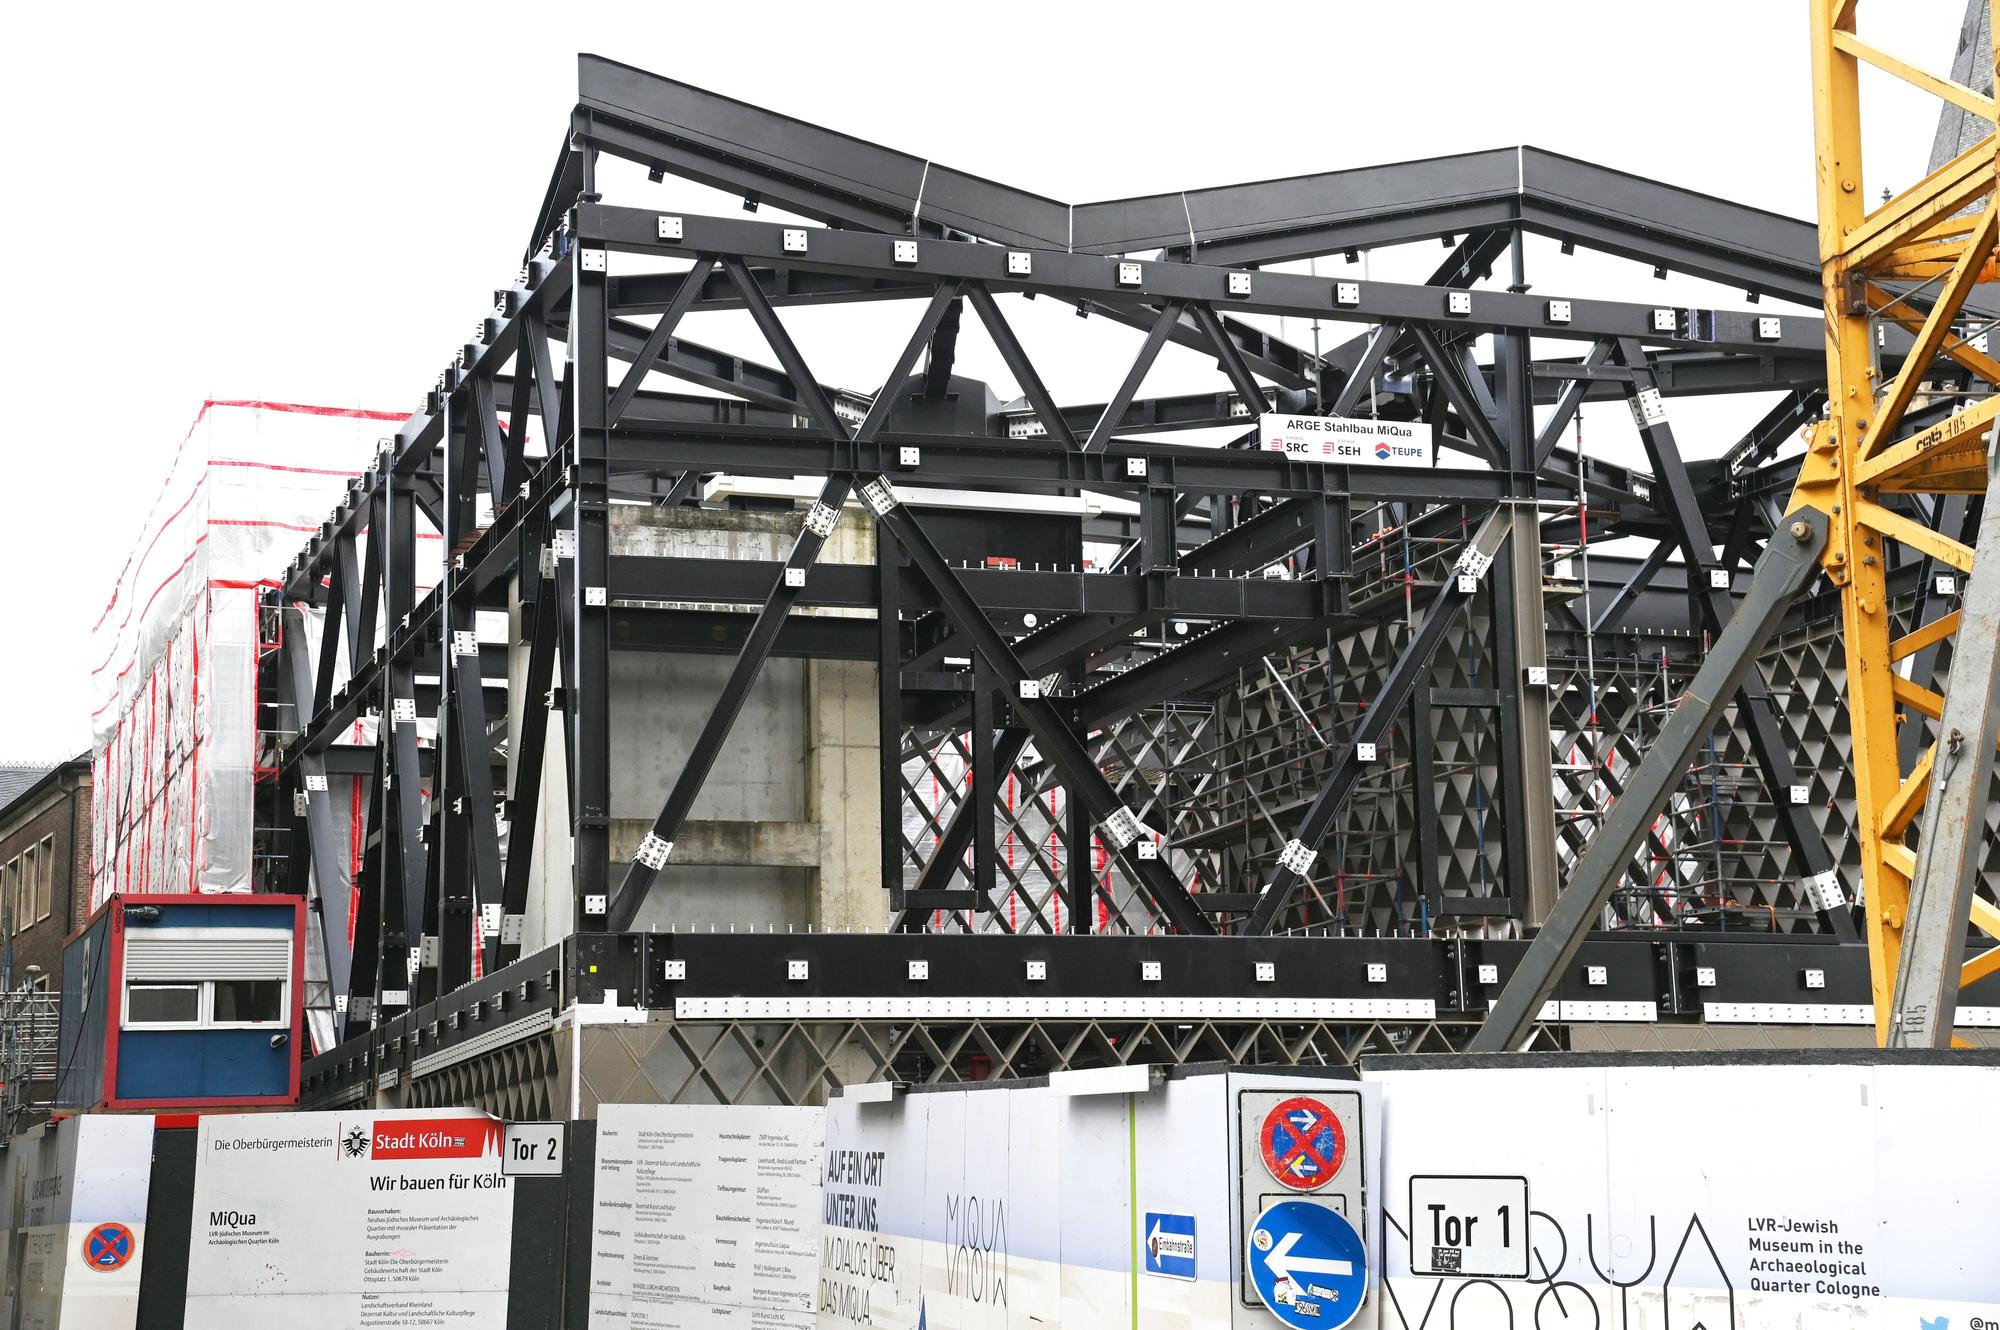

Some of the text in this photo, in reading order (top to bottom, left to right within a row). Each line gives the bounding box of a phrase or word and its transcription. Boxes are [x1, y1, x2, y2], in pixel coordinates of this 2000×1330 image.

[1286, 419, 1412, 437] ARGE Stahlbau MiQua
[1286, 442, 1308, 453] SRC
[1338, 446, 1360, 456] SEH
[1392, 446, 1422, 457] TEUPE
[214, 1138, 333, 1152] Die Oberbürgermeisterin
[376, 1132, 416, 1150] Stadt
[419, 1132, 452, 1148] Köln
[512, 1138, 557, 1161] Tor 2
[828, 1150, 885, 1187] AUF EIN ORT
[370, 1173, 506, 1190] Wir bauen für Köln
[210, 1211, 256, 1228] MiQua
[826, 1192, 878, 1232] UNTER UNS.
[1428, 1204, 1510, 1248] Tor 1
[1748, 1217, 1839, 1234] LVR-Jewish
[1159, 1237, 1193, 1254] Einbahnstraße
[1749, 1237, 1863, 1255] Museum in the
[823, 1235, 895, 1284] IM DIALOG ÜBER
[1750, 1258, 1866, 1277] Archaeological
[1750, 1278, 1880, 1299] Quarter Cologne
[820, 1278, 872, 1326] DAS MIQUA.
